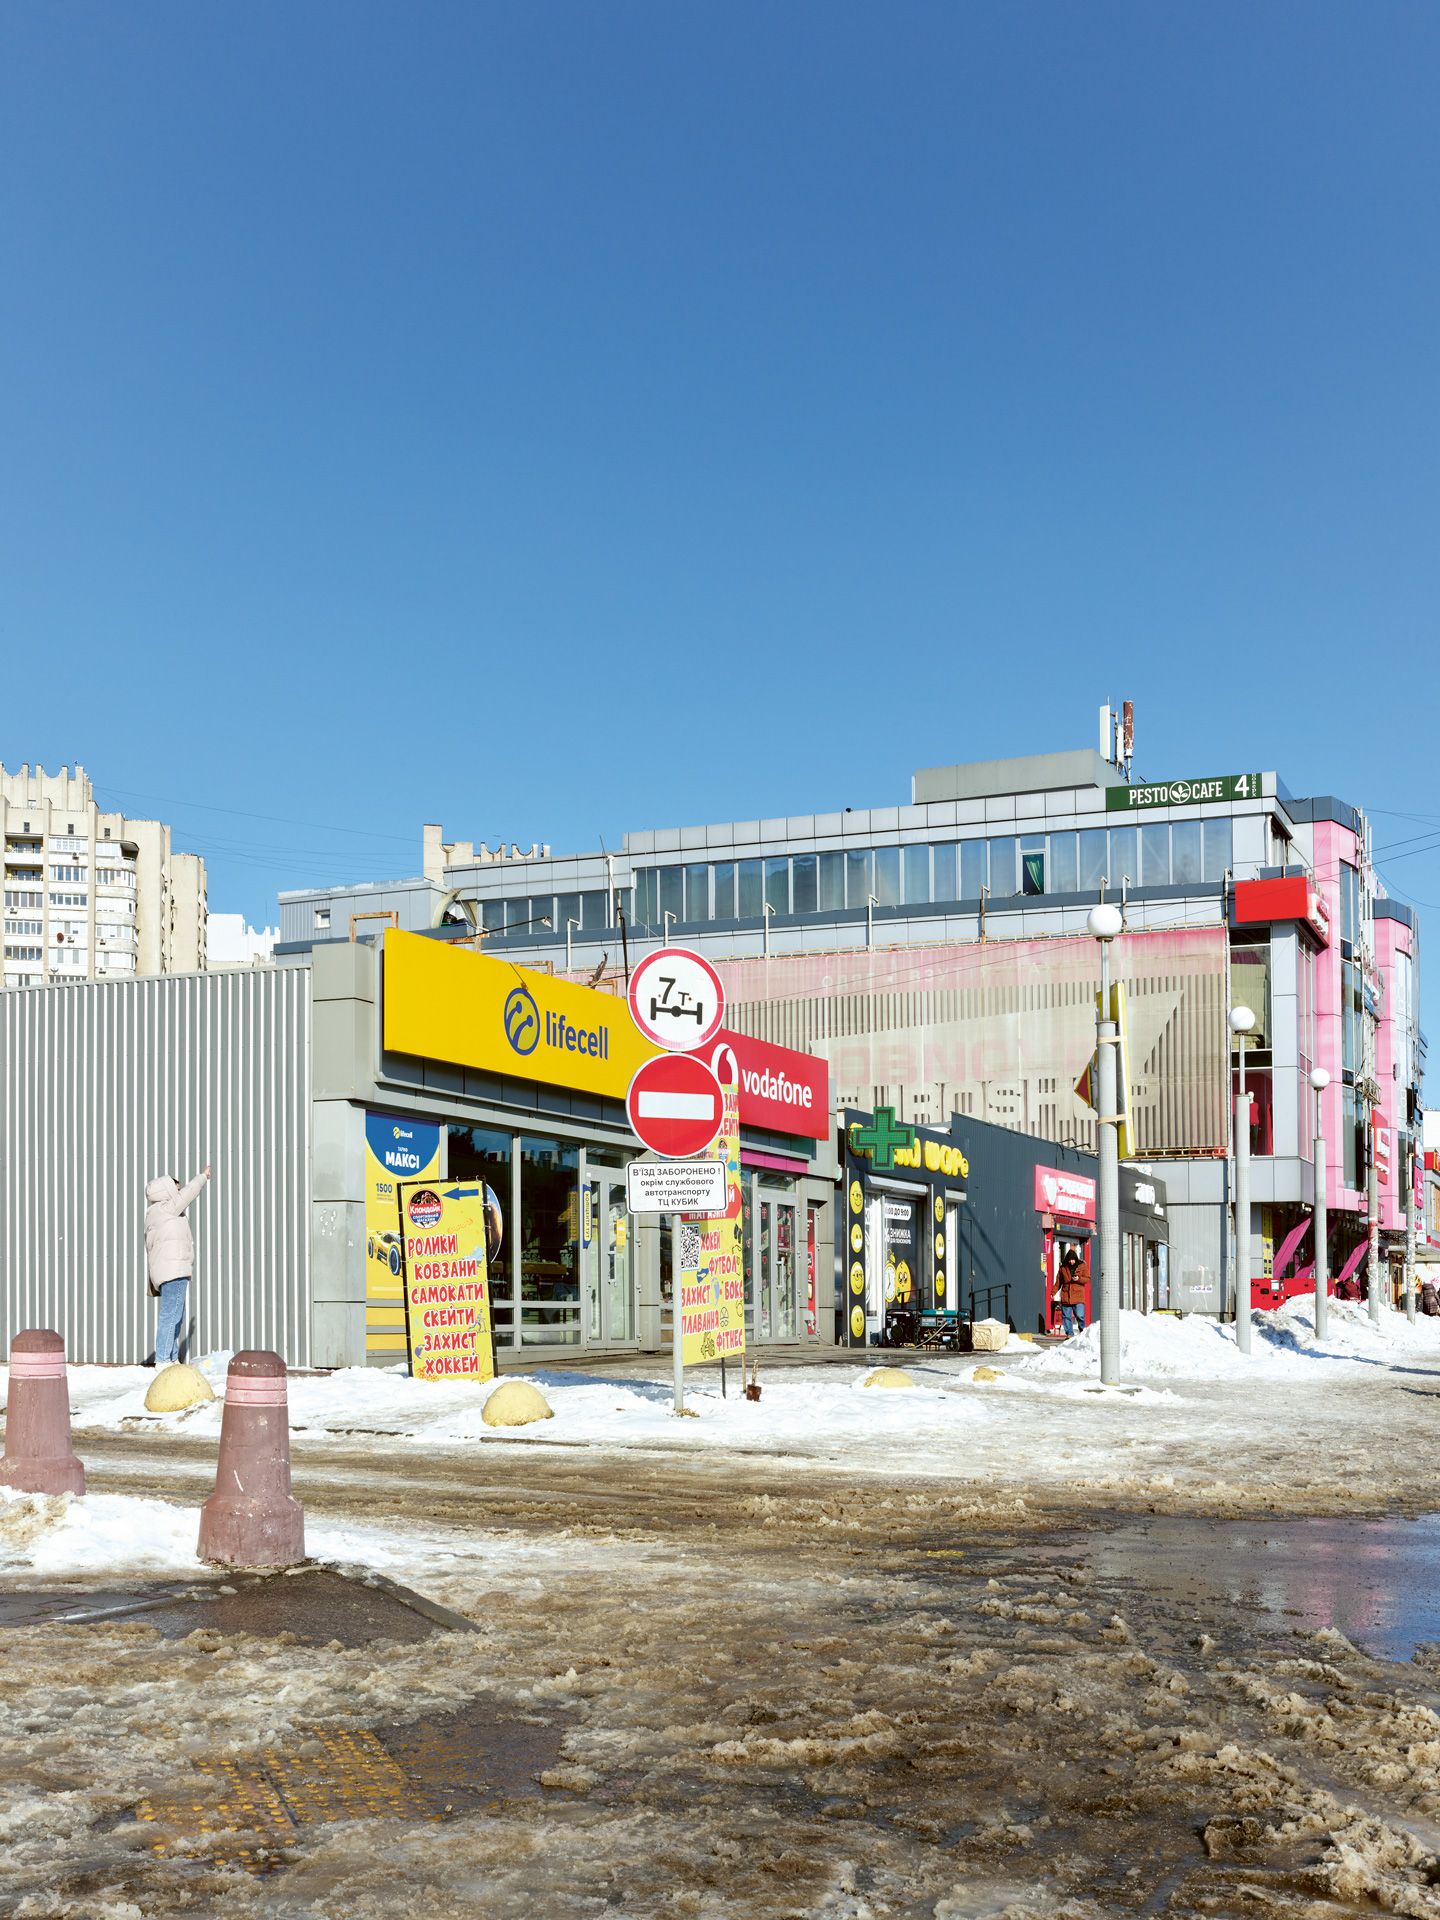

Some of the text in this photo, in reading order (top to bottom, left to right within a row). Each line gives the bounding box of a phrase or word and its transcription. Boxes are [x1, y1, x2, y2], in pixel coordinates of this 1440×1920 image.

[1129, 781, 1223, 805] PESTO CAFE
[1234, 775, 1249, 798] 4
[658, 976, 676, 1005] 7
[546, 1010, 608, 1060] lifecell
[742, 1068, 812, 1108] vodafone
[385, 1151, 420, 1169] МАКСІ
[640, 1178, 714, 1187] окрім службового
[657, 1167, 716, 1176] ЗАБОРОНЕНО
[376, 1183, 393, 1193] 1500
[644, 1189, 710, 1197] автотранспорту
[658, 1198, 699, 1207] ТЦ КУБИК
[890, 1228, 911, 1239] ЗНИЖКА
[406, 1233, 457, 1258] РОЛИКИ
[414, 1259, 477, 1281] КОВЗАНИ
[708, 1255, 737, 1277] ФУТБОЛ
[411, 1283, 485, 1305] САМОКАТИ
[681, 1280, 743, 1308] ЗАХИСТ БОКС
[423, 1306, 475, 1328] СКЕЙТИ
[682, 1310, 720, 1335] ПЛАВАННЯ
[423, 1332, 477, 1352] ЗАХИСТ
[715, 1329, 743, 1352] ФІТНЕС
[425, 1352, 480, 1376] ХОККЕЙ
